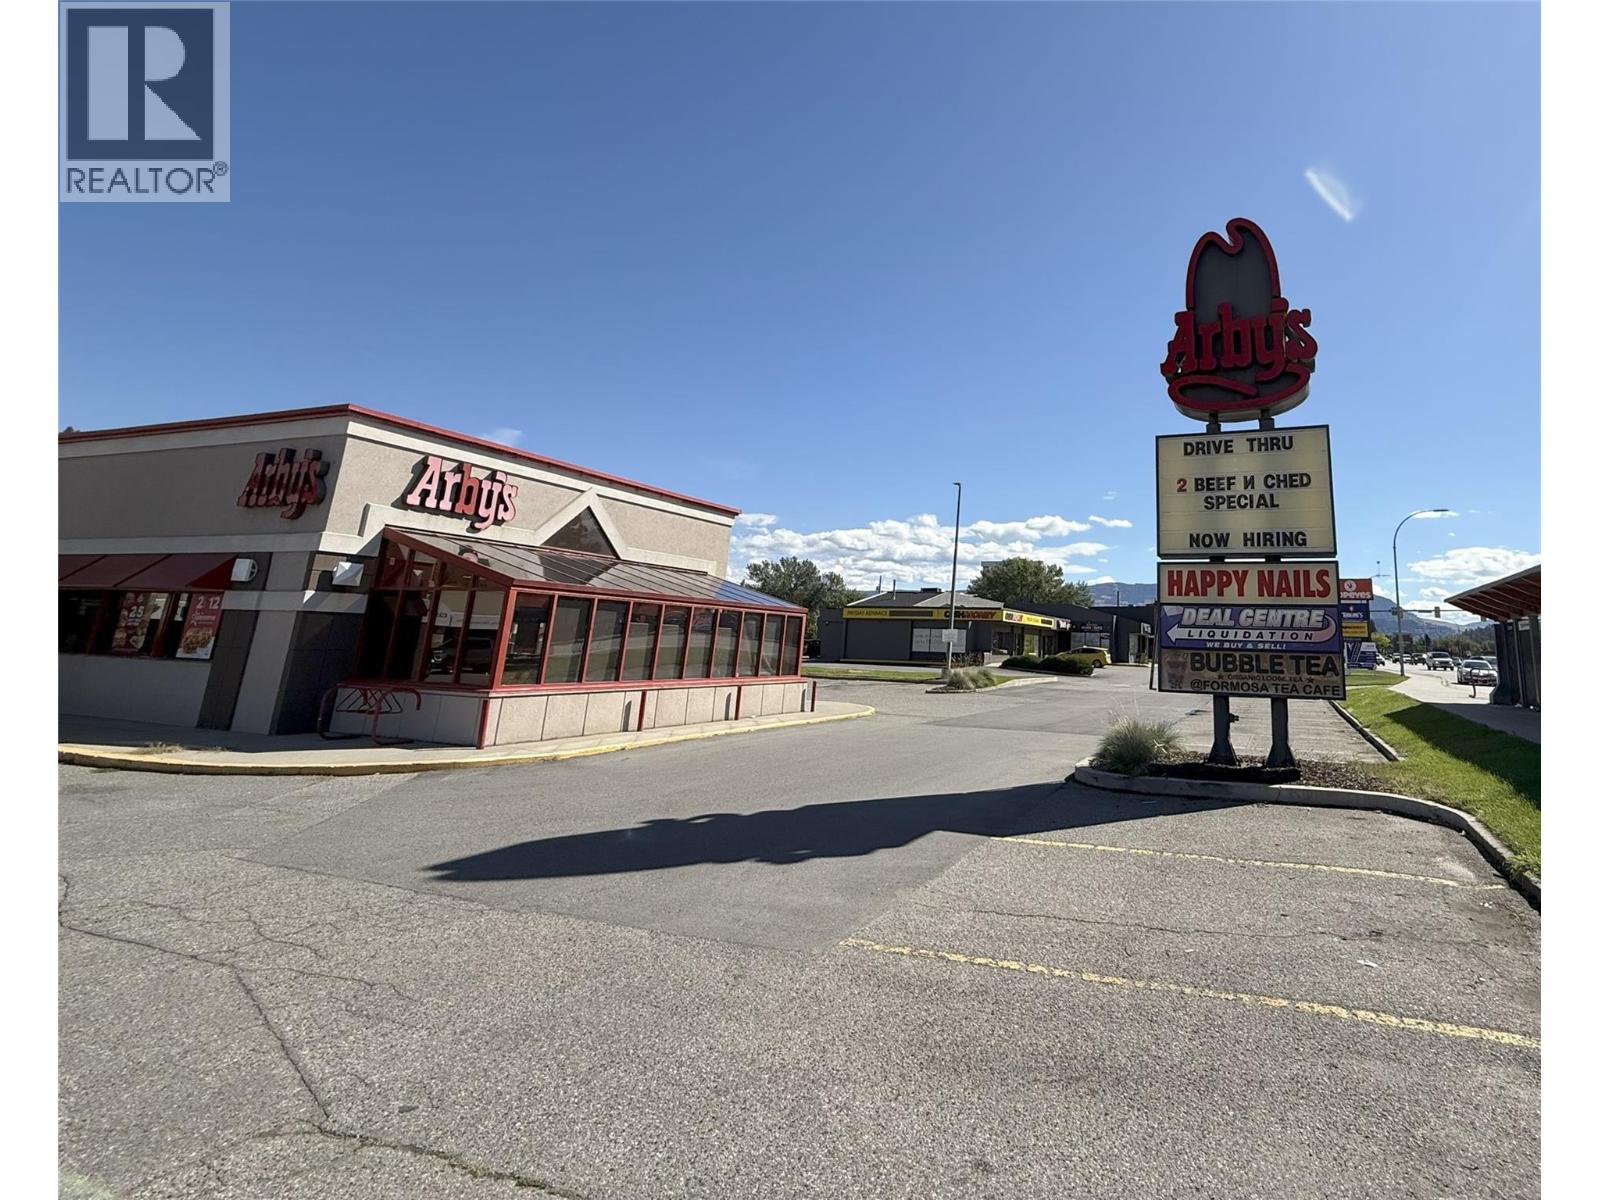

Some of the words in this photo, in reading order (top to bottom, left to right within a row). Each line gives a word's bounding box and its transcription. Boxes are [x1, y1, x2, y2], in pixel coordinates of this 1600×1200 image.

[1160, 297, 1318, 382] Arby's
[1183, 440, 1234, 456] DRIVE
[1246, 436, 1294, 452] THRU
[236, 448, 326, 520] Arby's
[407, 455, 519, 530] Arby's
[1176, 478, 1188, 493] 2
[1194, 476, 1236, 492] BEEF
[1263, 473, 1312, 489] CHED
[1203, 493, 1280, 510] SPECIAL
[1189, 533, 1231, 548] NOW
[1242, 531, 1308, 547] HIRING
[1167, 569, 1249, 597] HAPPY
[1257, 569, 1331, 598] NAILS
[1181, 608, 1235, 626] DEAL
[1238, 608, 1326, 628] CENTRE
[1187, 630, 1314, 641] LIQUIDATION
[1256, 642, 1287, 650] SELL!
[1189, 652, 1284, 675] BUBBLE
[1289, 655, 1340, 676] TEA
[1190, 679, 1269, 693] @FORMOSA
[1272, 683, 1302, 694] TEA
[1302, 684, 1341, 696] CAFE
